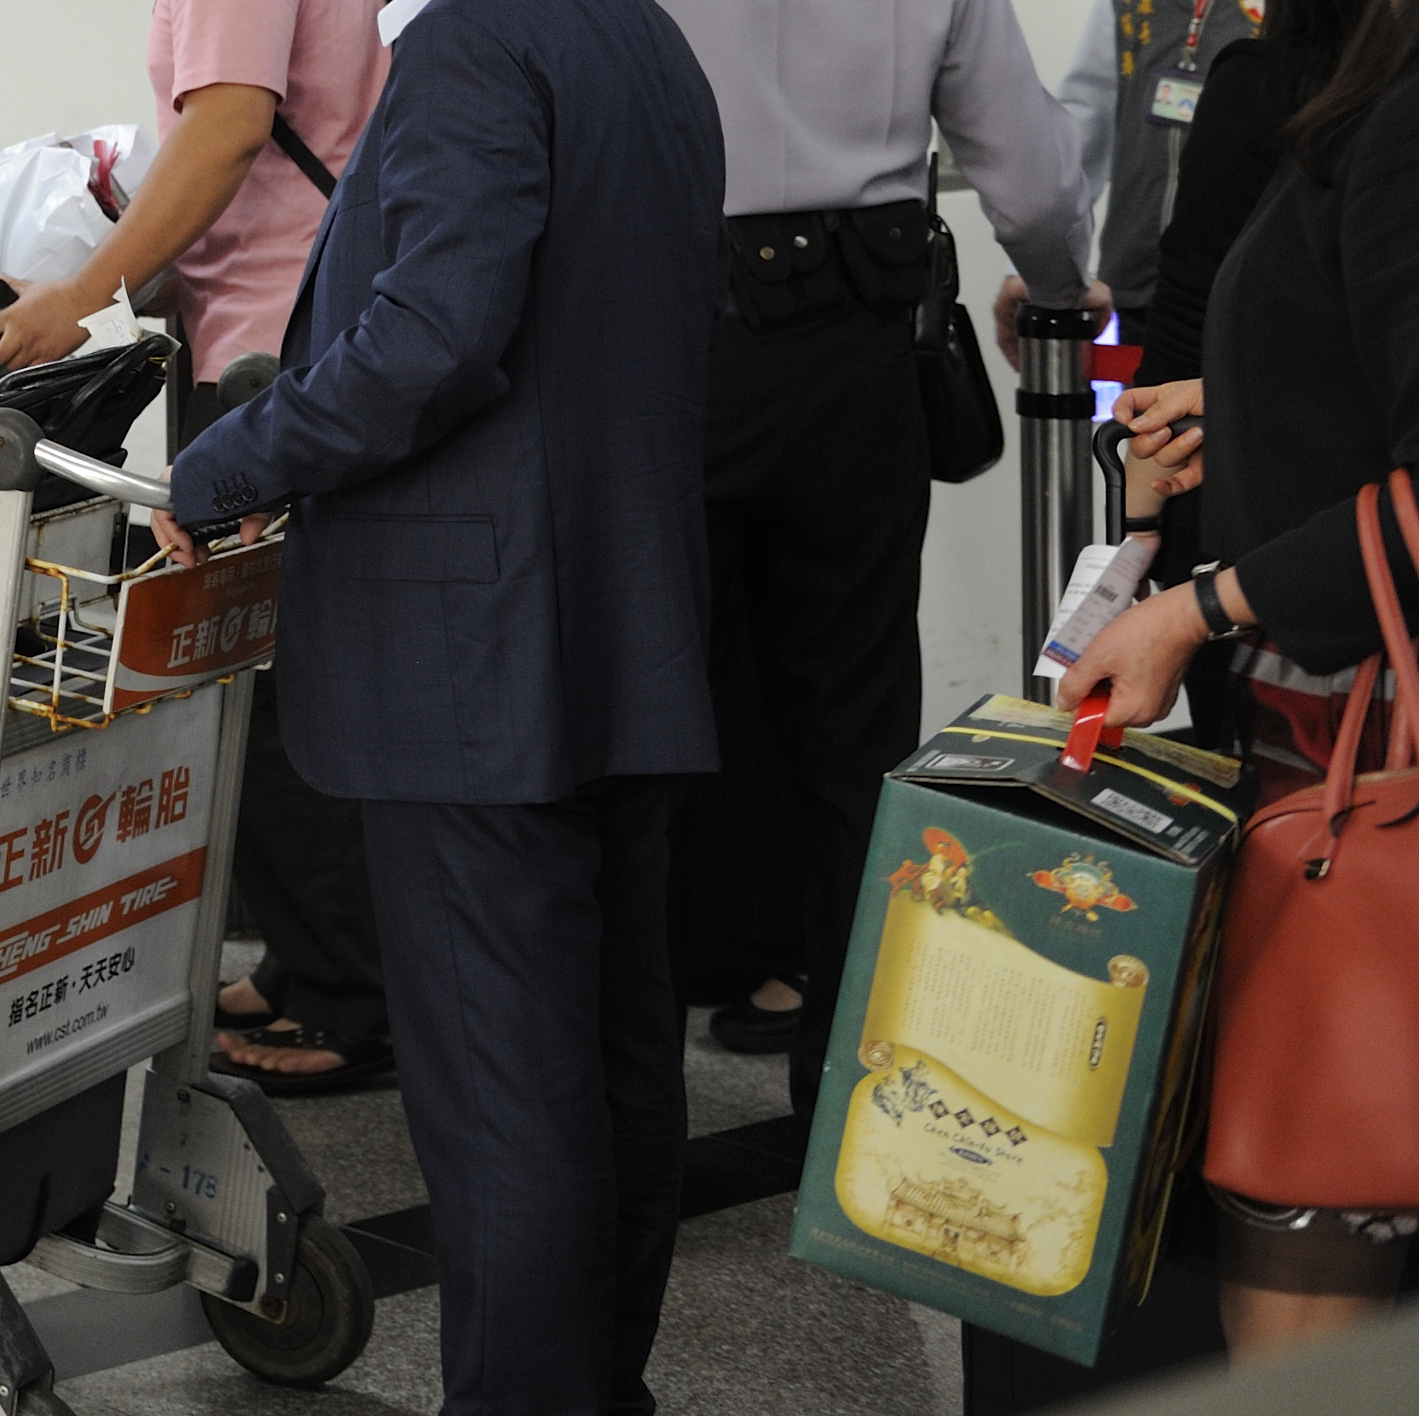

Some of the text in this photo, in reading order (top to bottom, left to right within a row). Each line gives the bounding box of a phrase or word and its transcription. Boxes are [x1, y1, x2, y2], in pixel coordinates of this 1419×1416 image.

[55, 900, 114, 945] SHIN
[120, 876, 179, 916] TIRE
[26, 1002, 110, 1055] www.cst.com.tw
